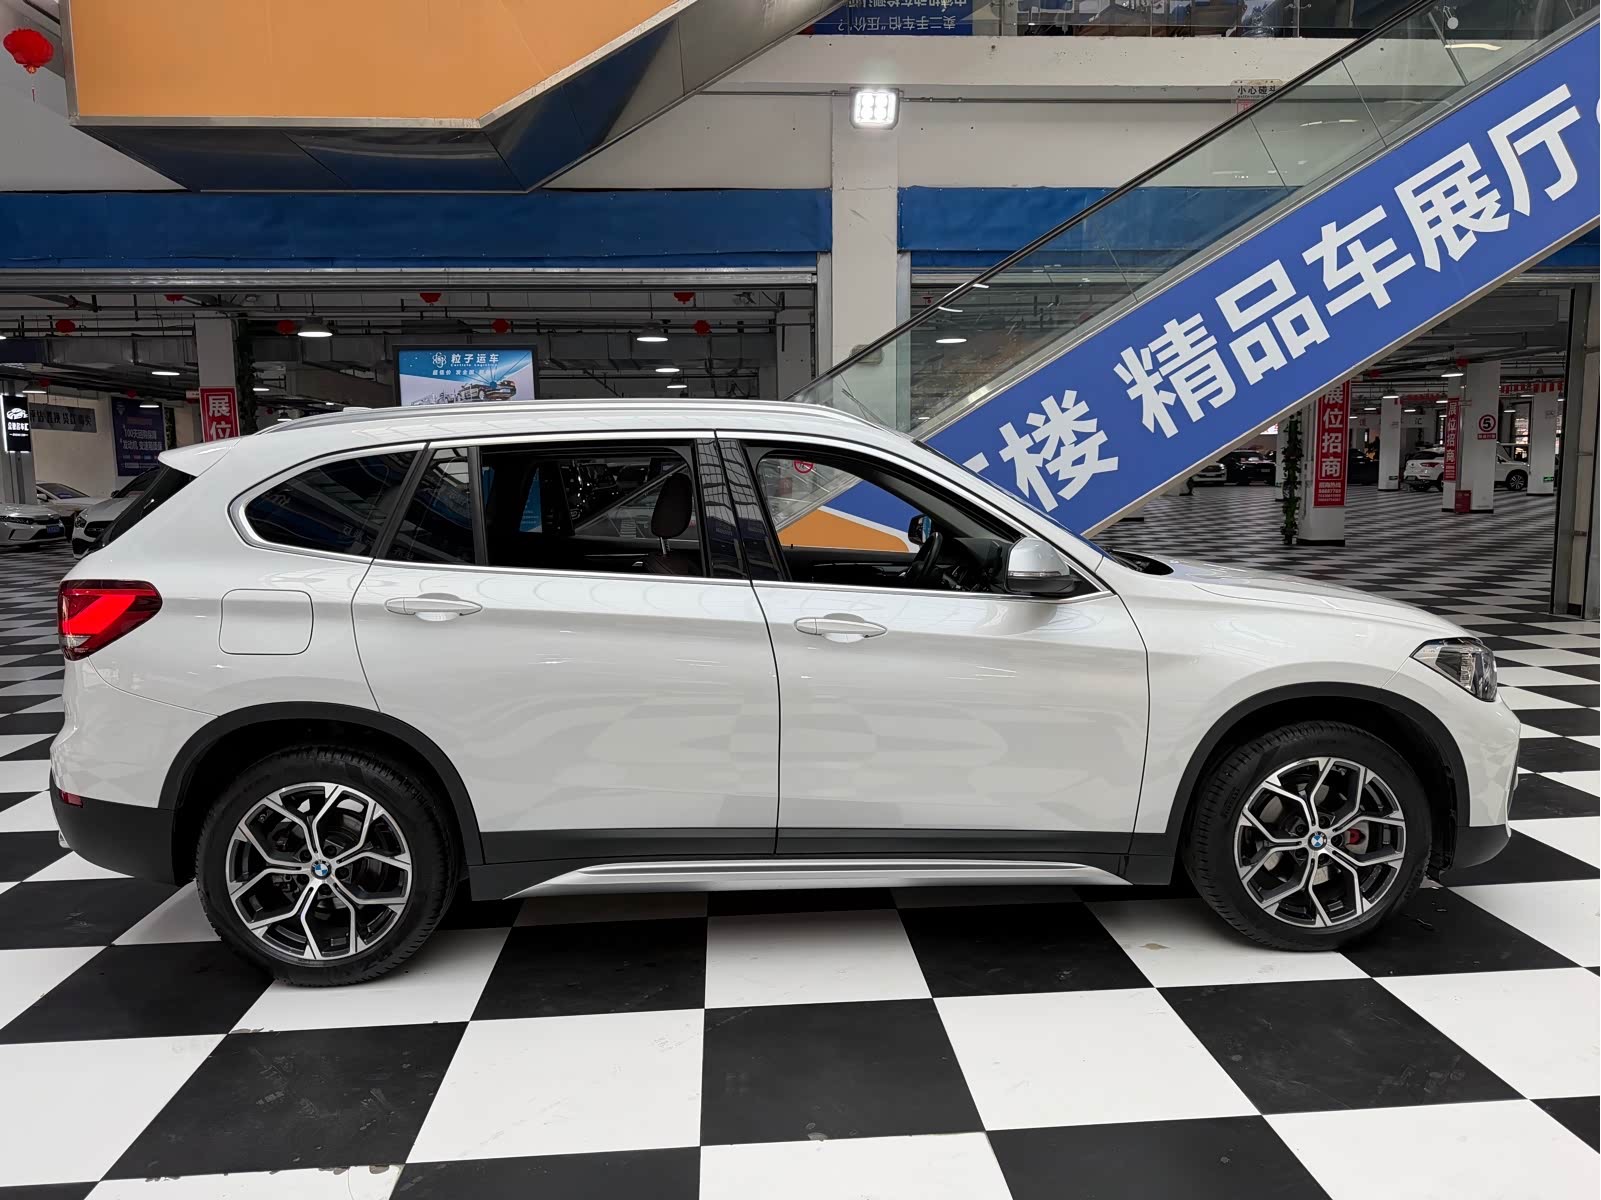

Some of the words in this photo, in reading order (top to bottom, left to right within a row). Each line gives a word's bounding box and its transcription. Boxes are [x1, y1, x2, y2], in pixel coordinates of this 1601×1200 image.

[1114, 84, 1580, 438] 精品车展厅
[451, 353, 499, 363] 粒子运车
[208, 395, 232, 441] 展位
[1321, 386, 1344, 477] 展位招商
[1482, 418, 1491, 429] 5
